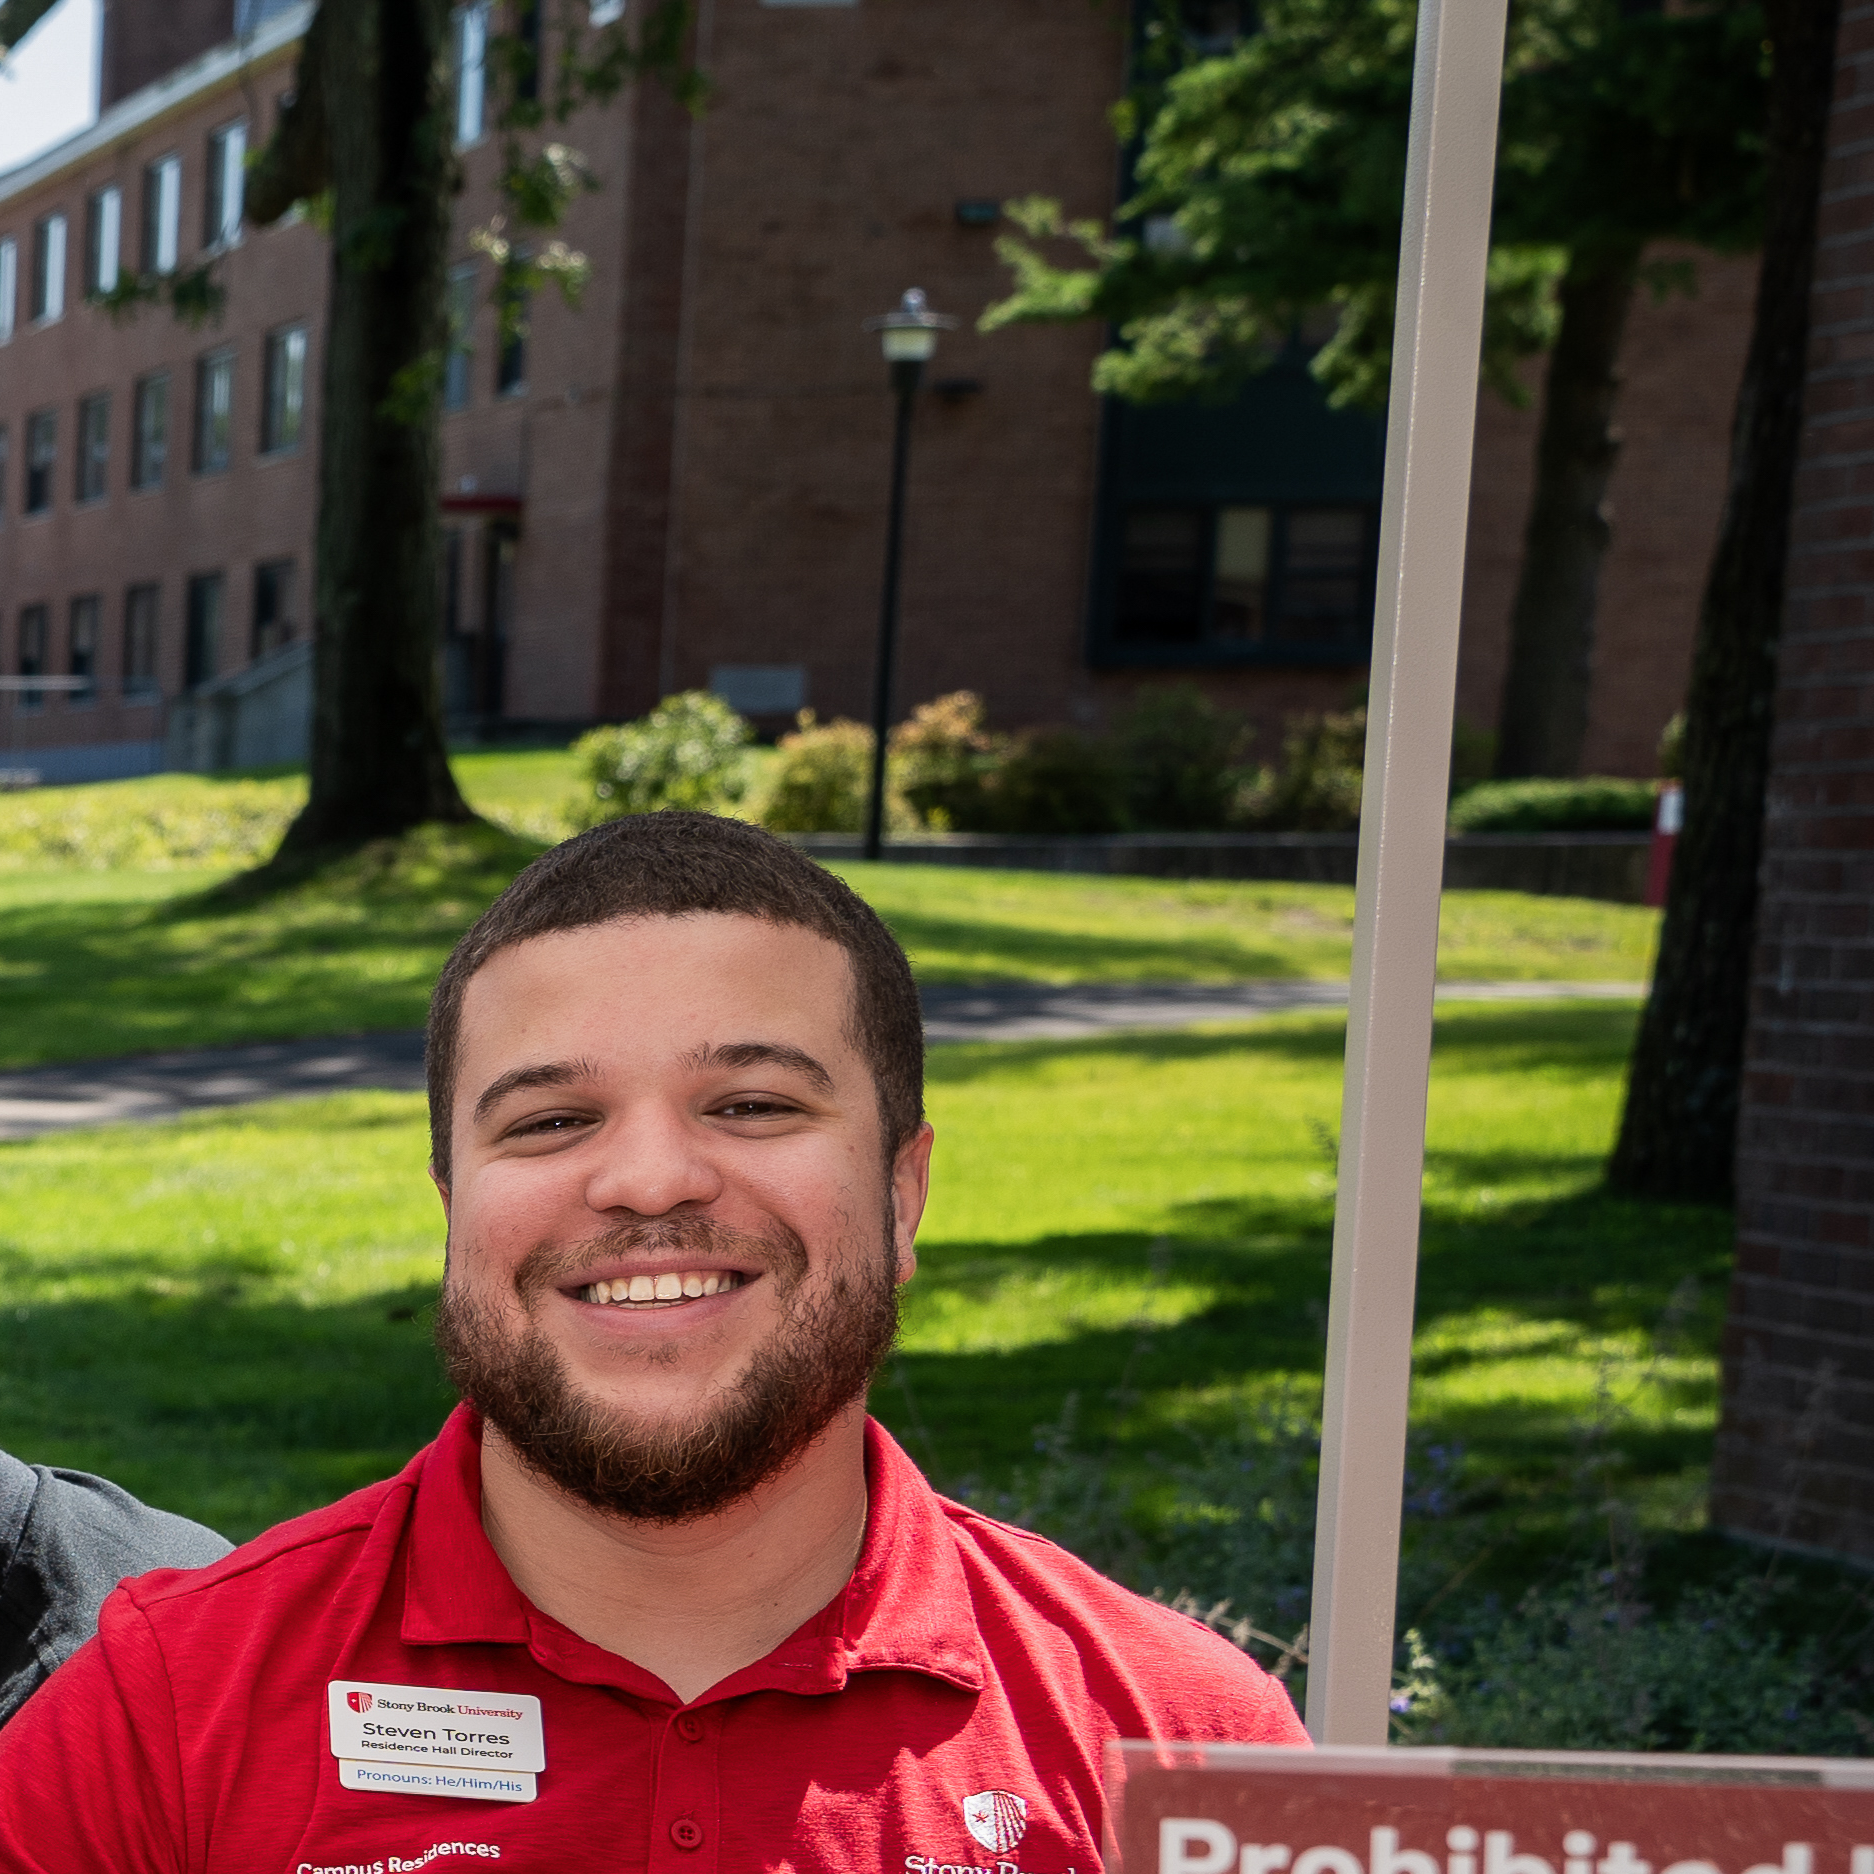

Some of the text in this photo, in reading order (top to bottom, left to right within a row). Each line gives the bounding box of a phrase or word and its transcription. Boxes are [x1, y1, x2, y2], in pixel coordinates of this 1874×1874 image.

[377, 1698, 523, 1721] Stony Brook University
[362, 1722, 510, 1746] Steven Torres
[361, 1740, 513, 1760] Residence Hall Director
[357, 1769, 522, 1793] Pronouns: He/Him/His
[388, 1841, 501, 1873] Residences
